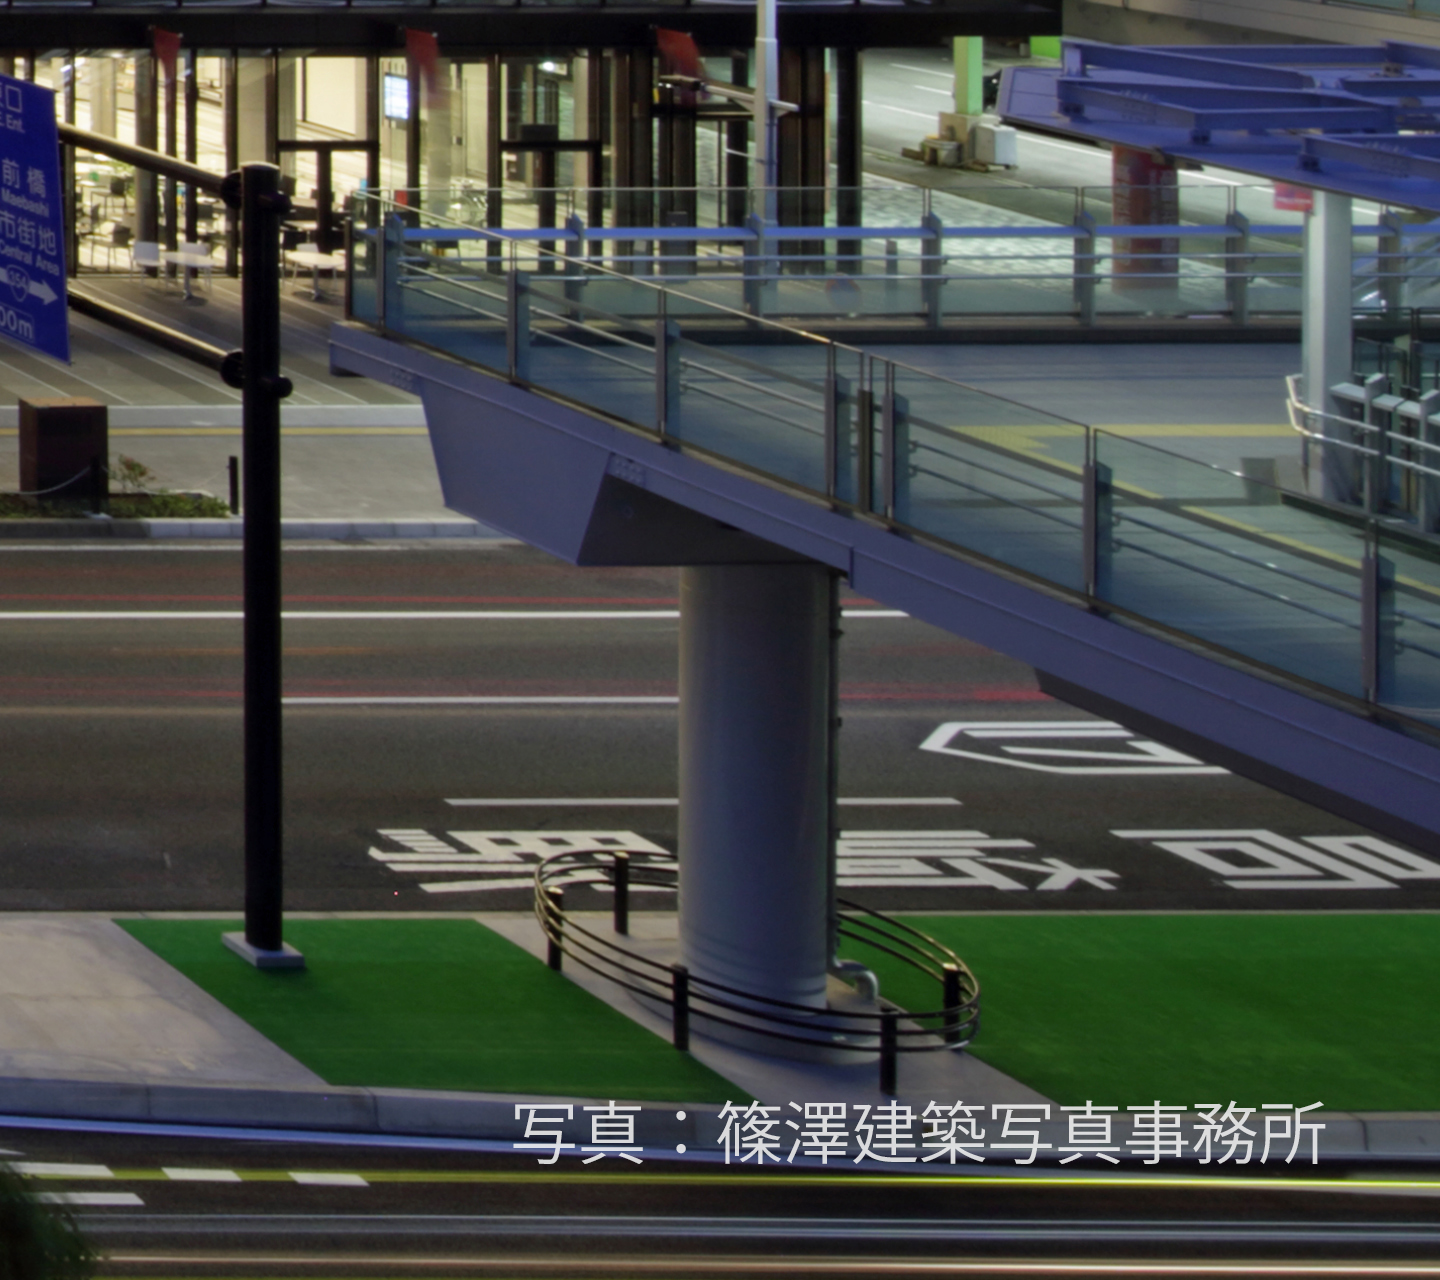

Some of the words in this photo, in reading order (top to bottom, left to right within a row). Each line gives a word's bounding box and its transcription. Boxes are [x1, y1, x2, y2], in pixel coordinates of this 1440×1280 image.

[1, 157, 47, 199] 前橋
[0, 187, 50, 217] Maebashi
[35, 253, 60, 277] Area
[8, 269, 27, 289] 354
